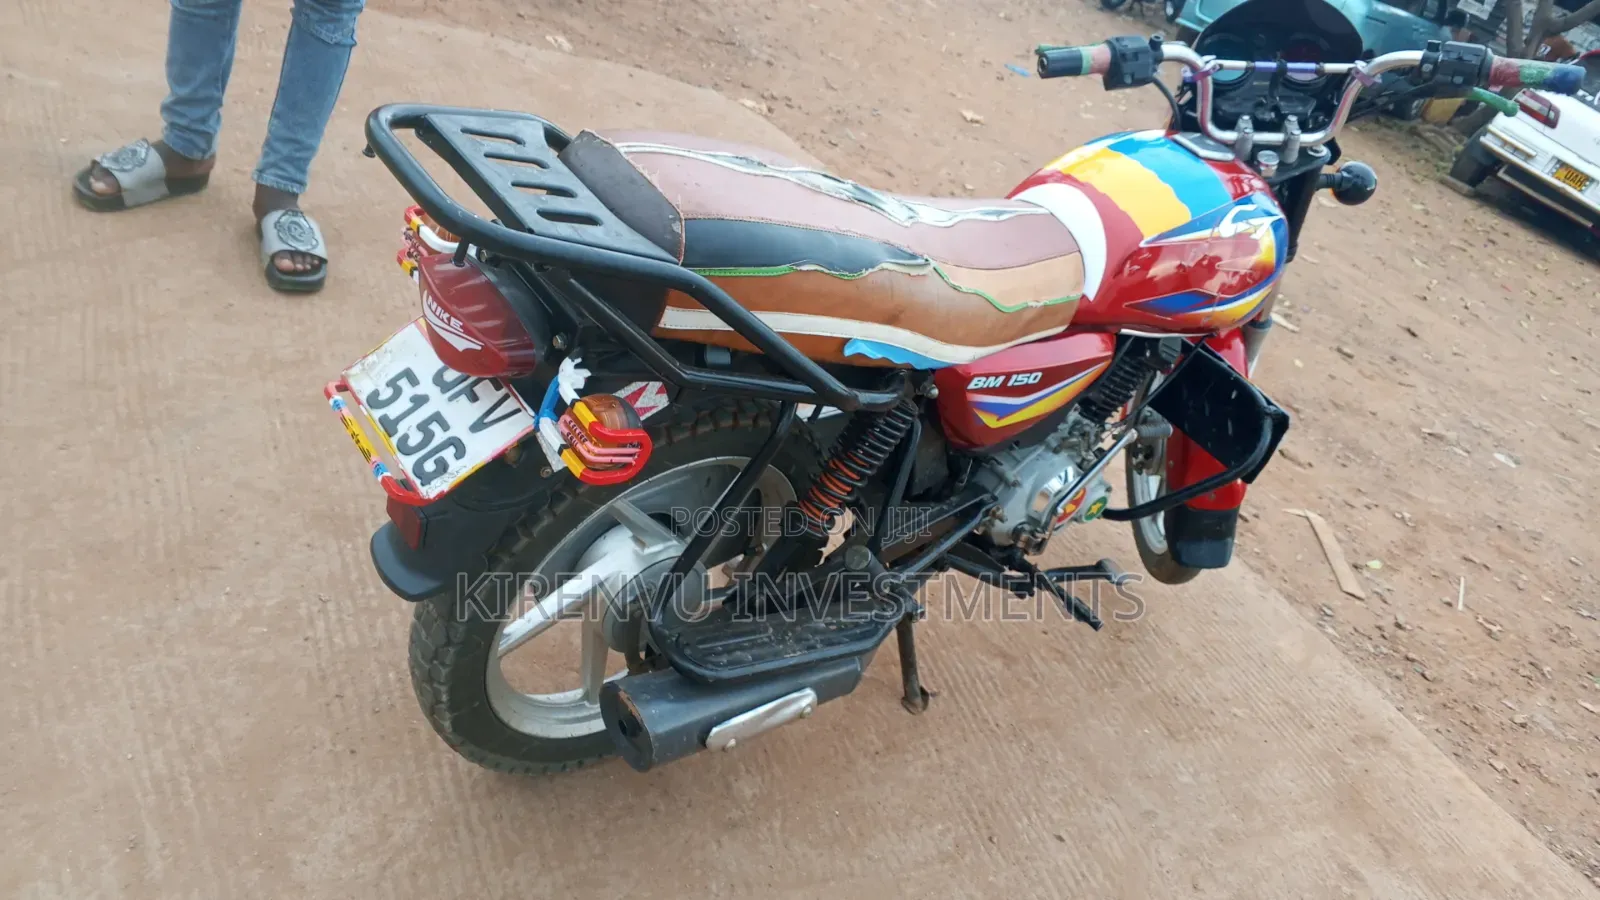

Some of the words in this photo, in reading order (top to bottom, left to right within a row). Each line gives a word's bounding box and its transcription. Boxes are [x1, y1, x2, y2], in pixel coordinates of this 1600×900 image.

[427, 294, 464, 333] NIKE
[966, 375, 1006, 390] BM
[1007, 371, 1043, 387] 150
[366, 367, 466, 487] 515G
